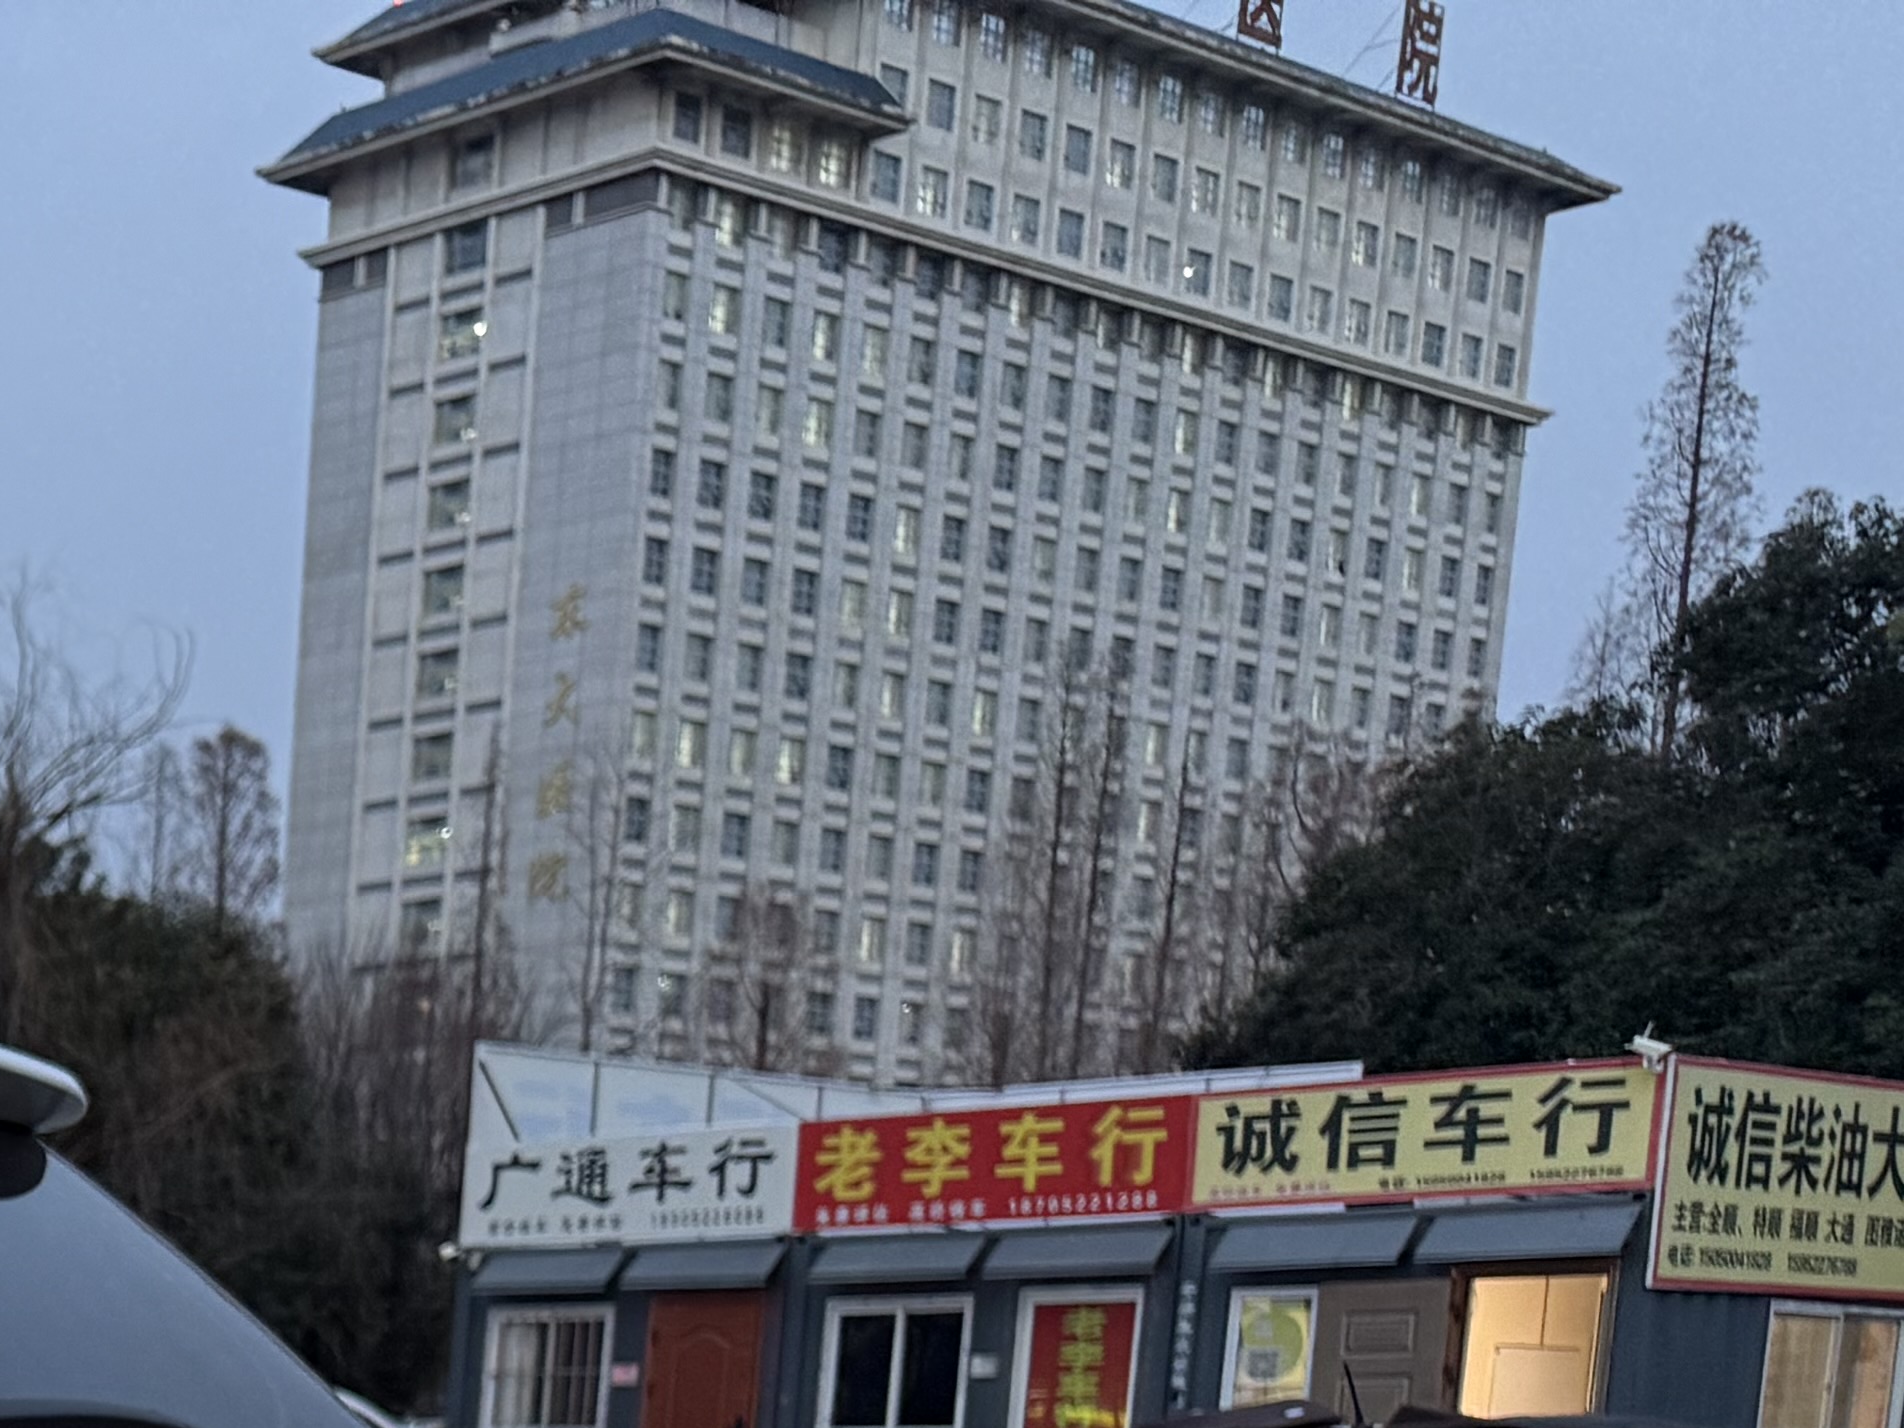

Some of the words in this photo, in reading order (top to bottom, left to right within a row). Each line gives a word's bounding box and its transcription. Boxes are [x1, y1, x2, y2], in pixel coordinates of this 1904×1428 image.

[479, 1138, 777, 1211] 广通车行
[813, 1103, 1169, 1200] 老李车行
[1215, 1075, 1632, 1176] 诚信车行
[1686, 1084, 1904, 1201] 诚信柴油大
